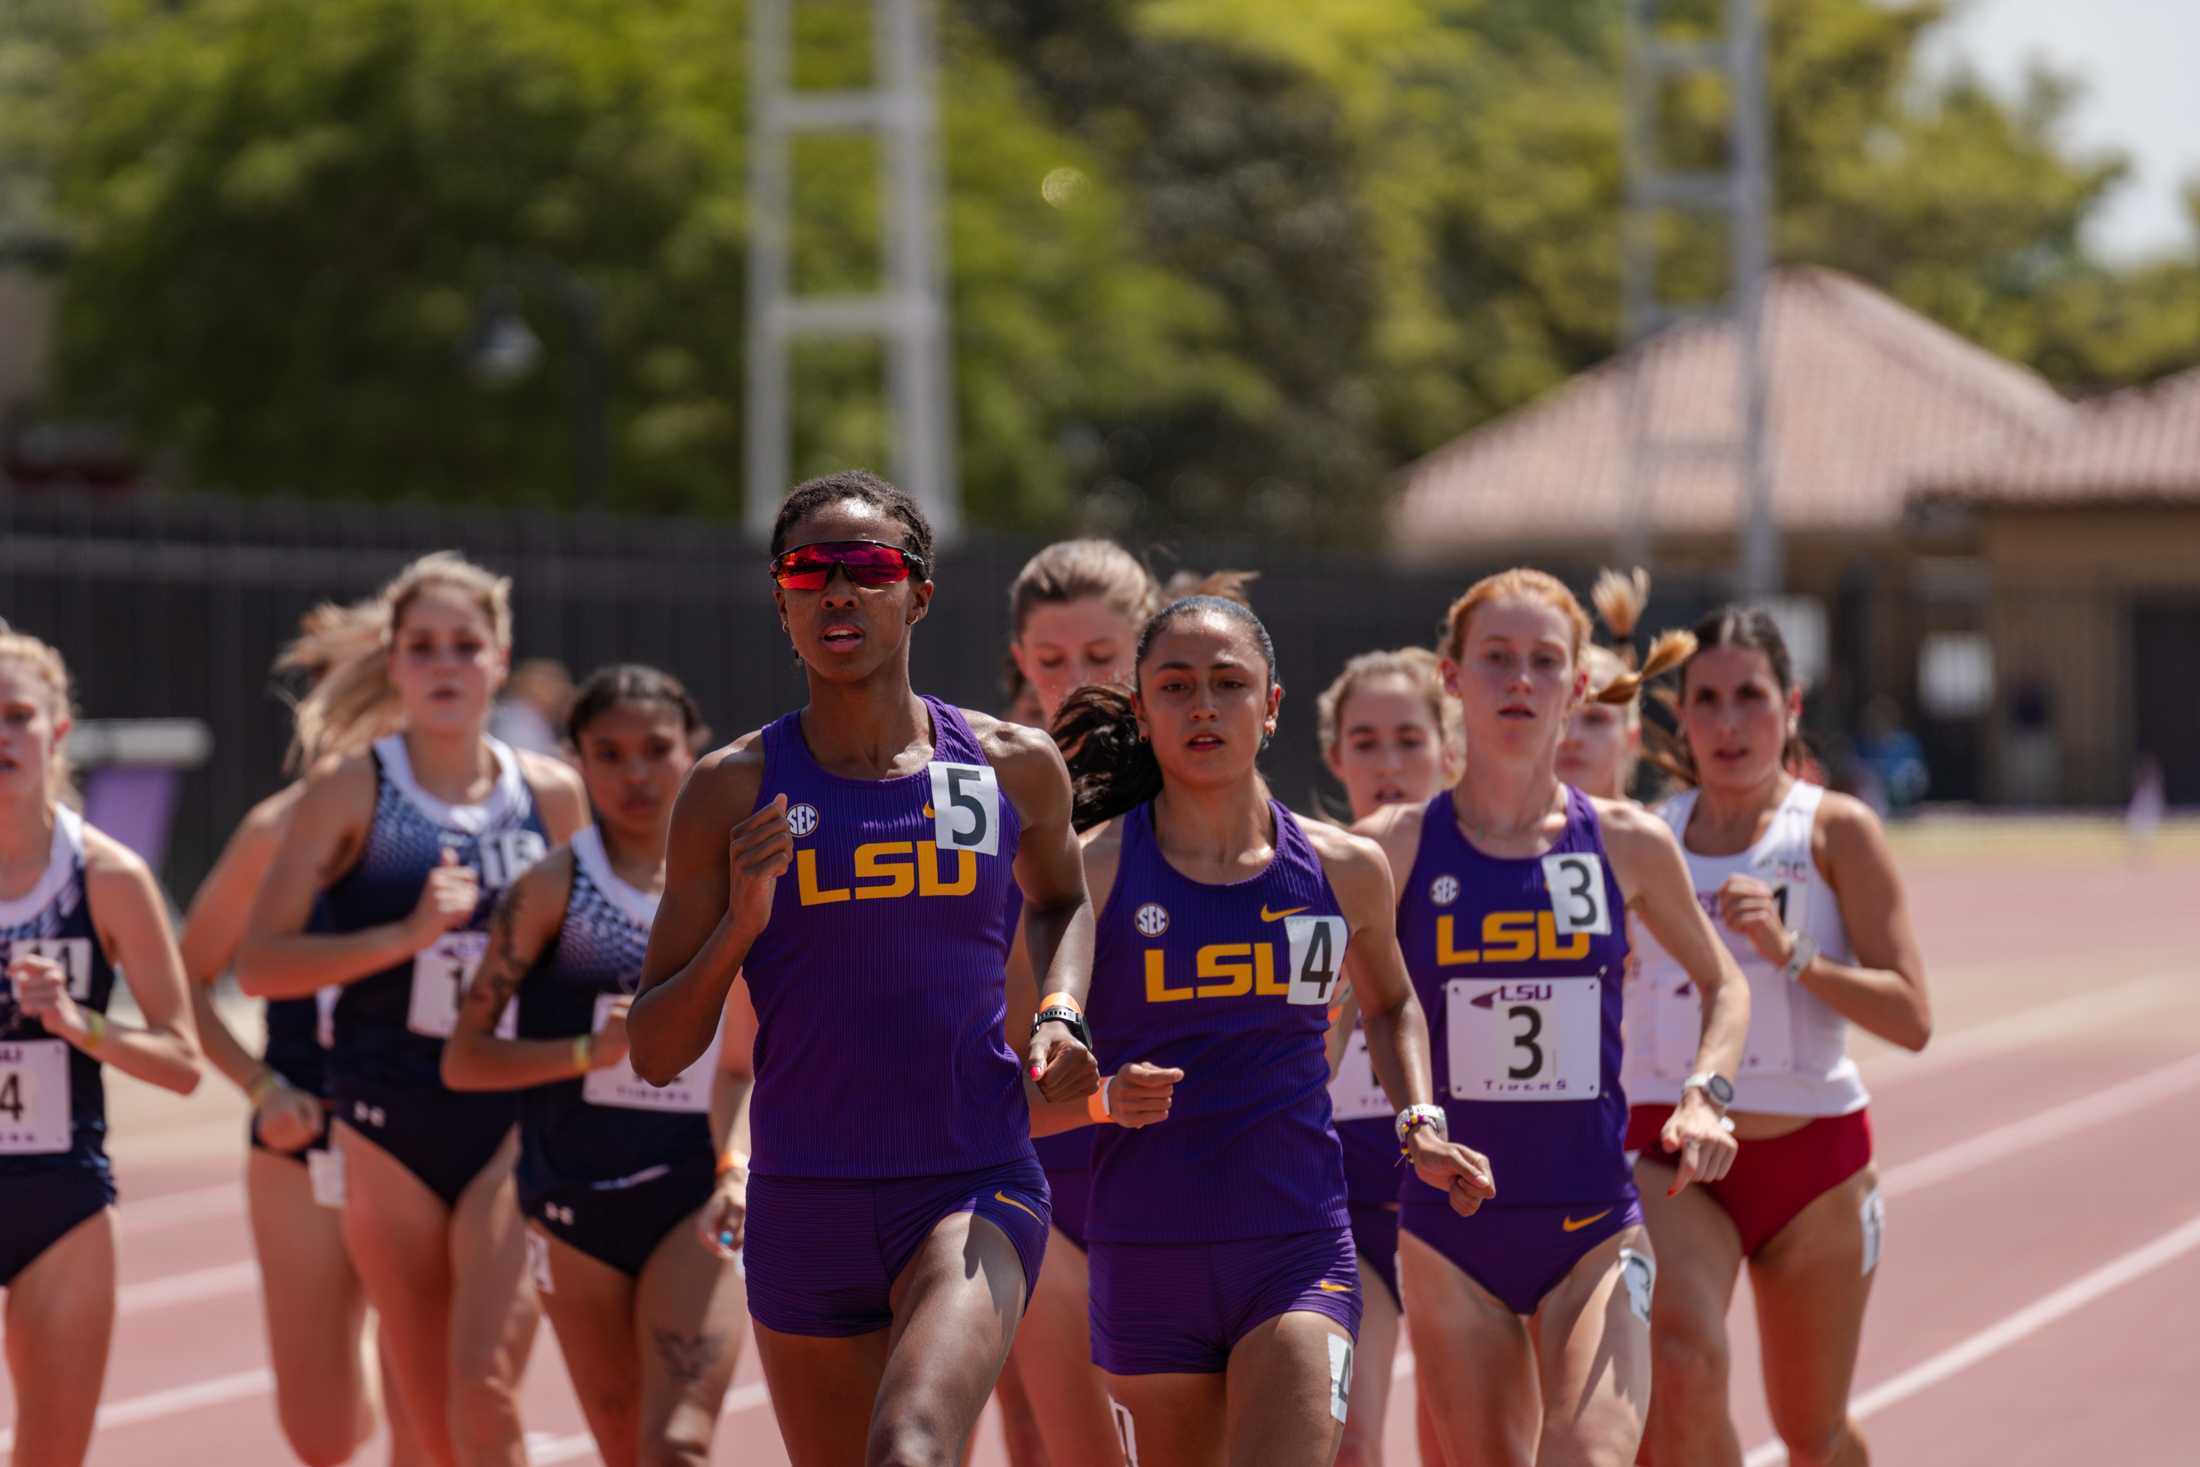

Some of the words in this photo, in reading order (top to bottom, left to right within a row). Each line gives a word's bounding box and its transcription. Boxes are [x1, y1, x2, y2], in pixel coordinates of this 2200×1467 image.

[786, 805, 816, 835] SEC
[946, 767, 987, 847] 5
[796, 840, 977, 906] LSU
[1559, 858, 1598, 928] 3
[1136, 905, 1168, 935] SEC
[1435, 911, 1591, 966] LSU
[1300, 921, 1334, 999] 4
[1500, 985, 1552, 1001] LSU
[1507, 1004, 1544, 1081] 3
